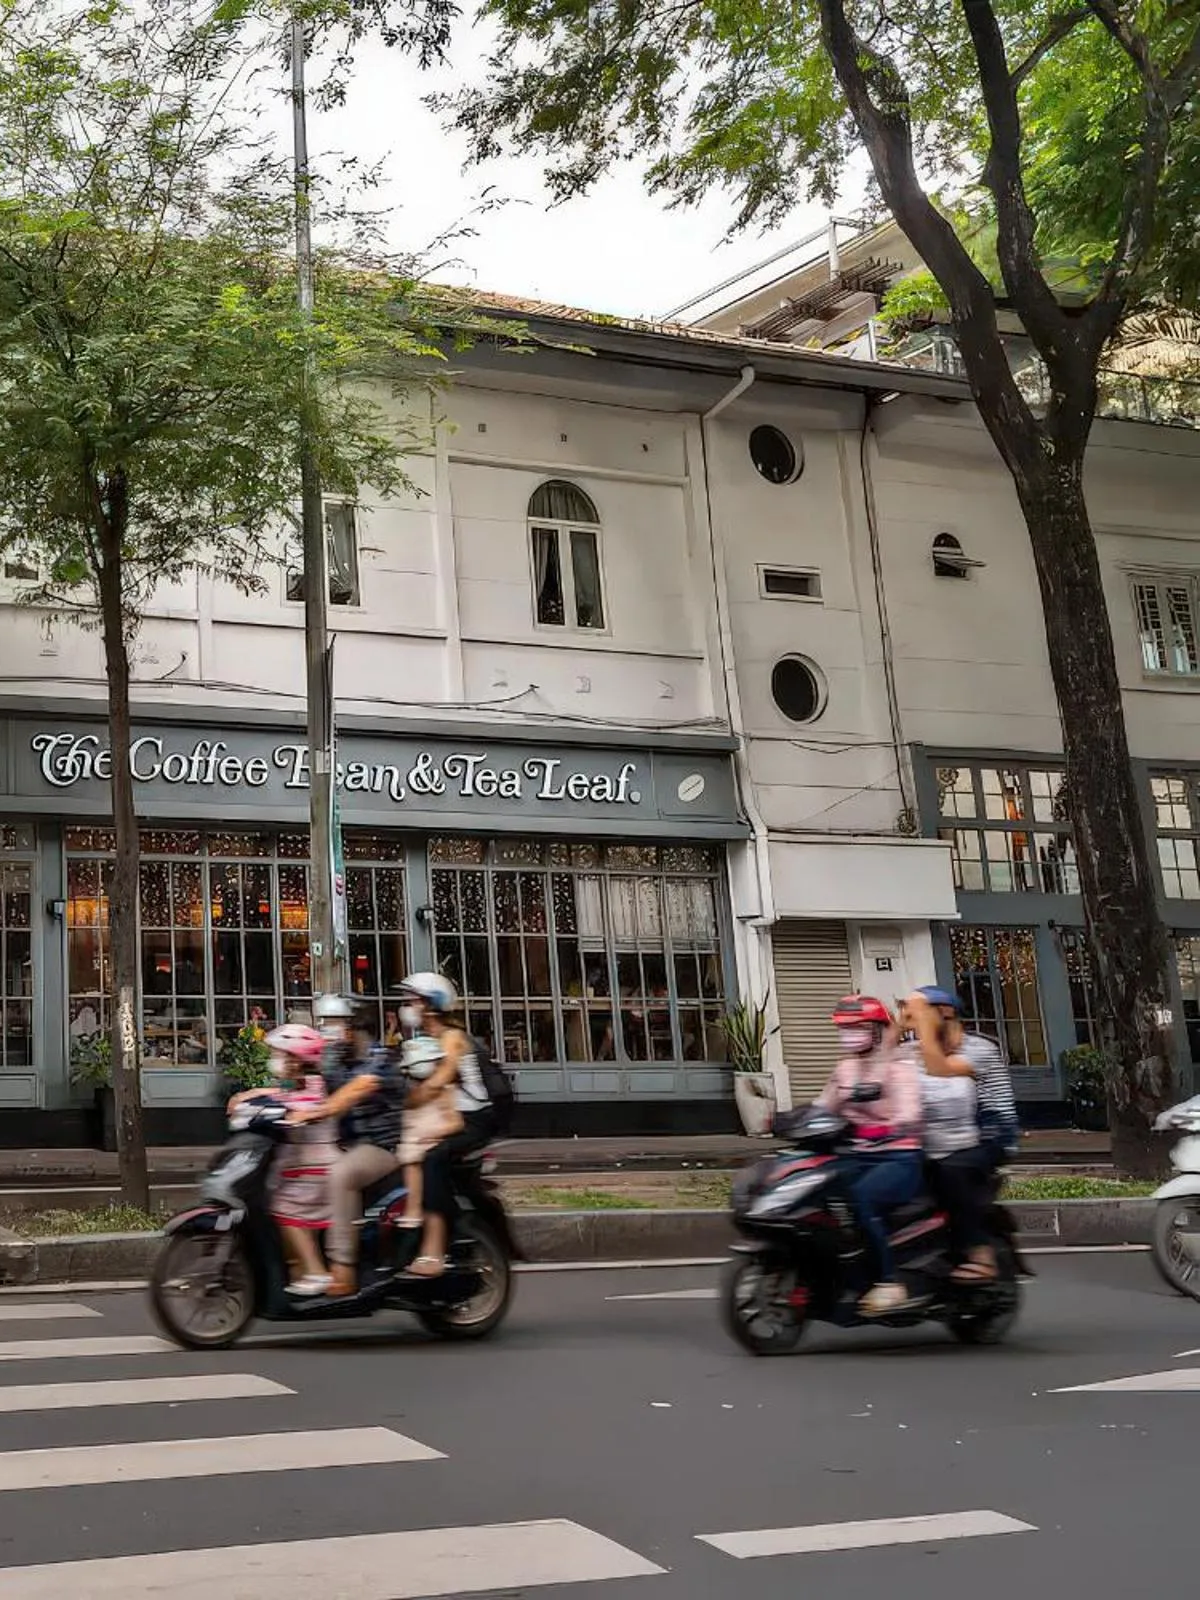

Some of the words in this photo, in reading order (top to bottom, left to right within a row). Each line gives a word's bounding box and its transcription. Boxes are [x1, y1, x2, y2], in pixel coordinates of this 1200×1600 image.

[31, 732, 112, 788] The
[129, 736, 269, 786] Coffee
[407, 751, 446, 795] &
[443, 752, 522, 797] Tea
[523, 758, 642, 804] Leaf.
